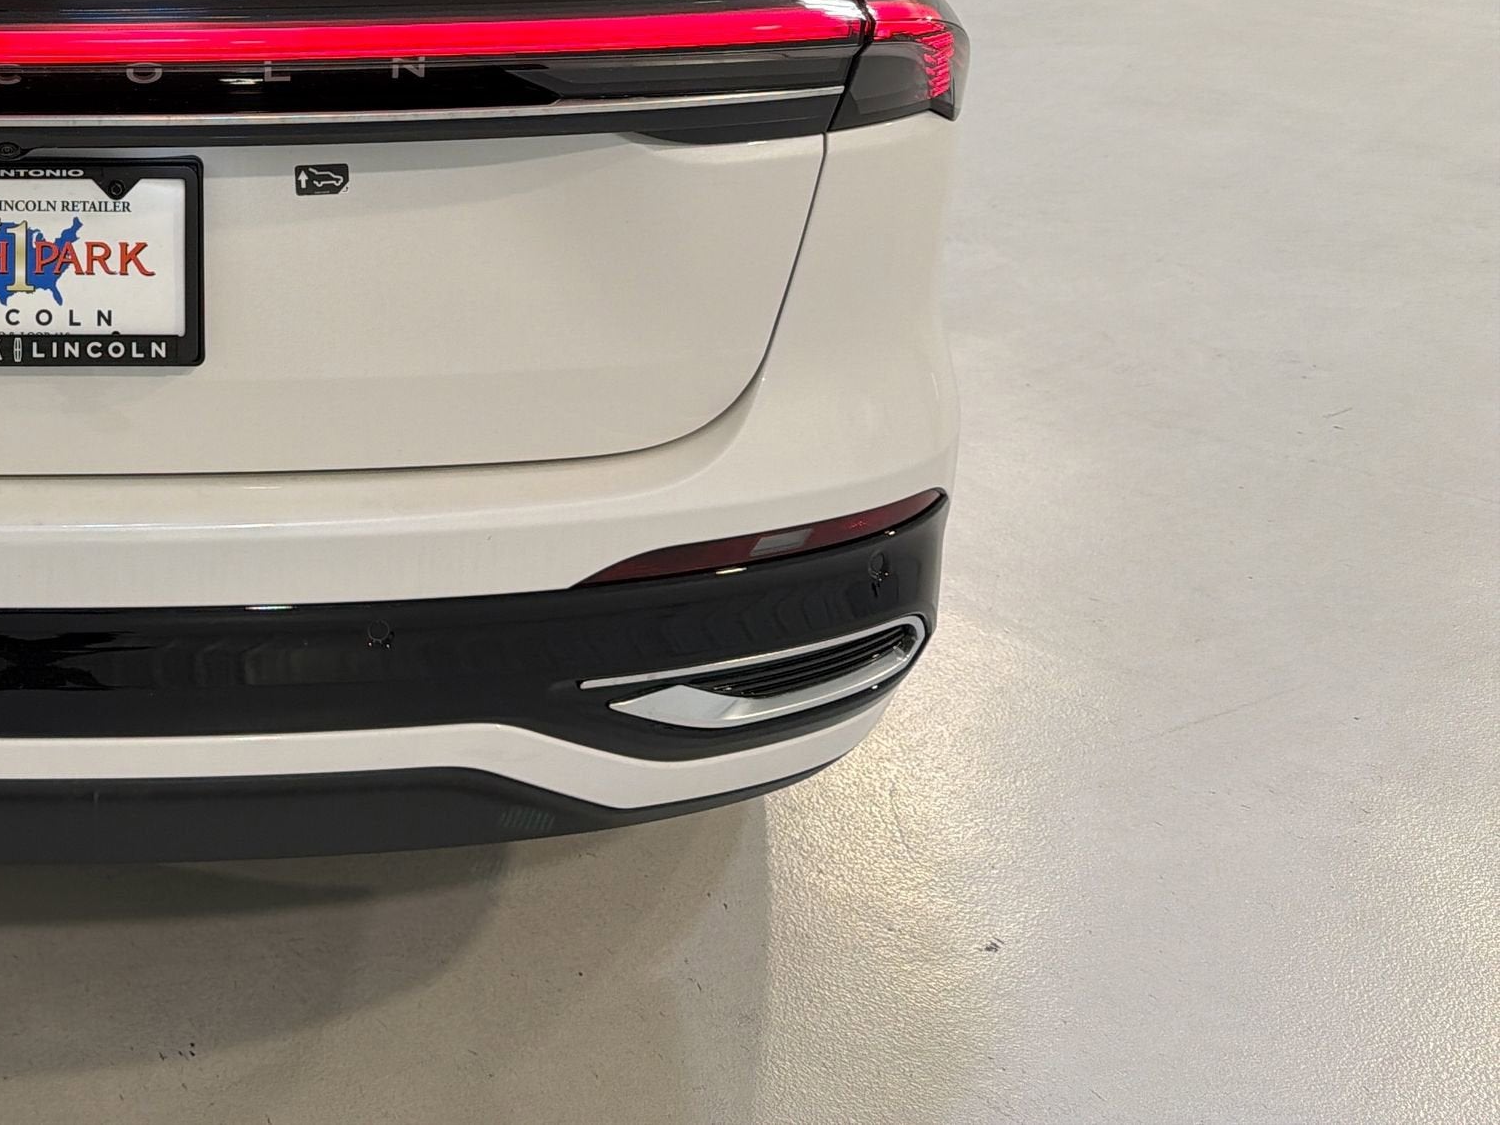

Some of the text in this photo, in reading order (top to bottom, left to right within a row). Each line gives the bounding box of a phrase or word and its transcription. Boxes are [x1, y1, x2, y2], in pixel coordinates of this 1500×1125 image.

[60, 200, 132, 213] RETAILER
[34, 241, 156, 276] PARK
[32, 341, 167, 359] LINCOLN
